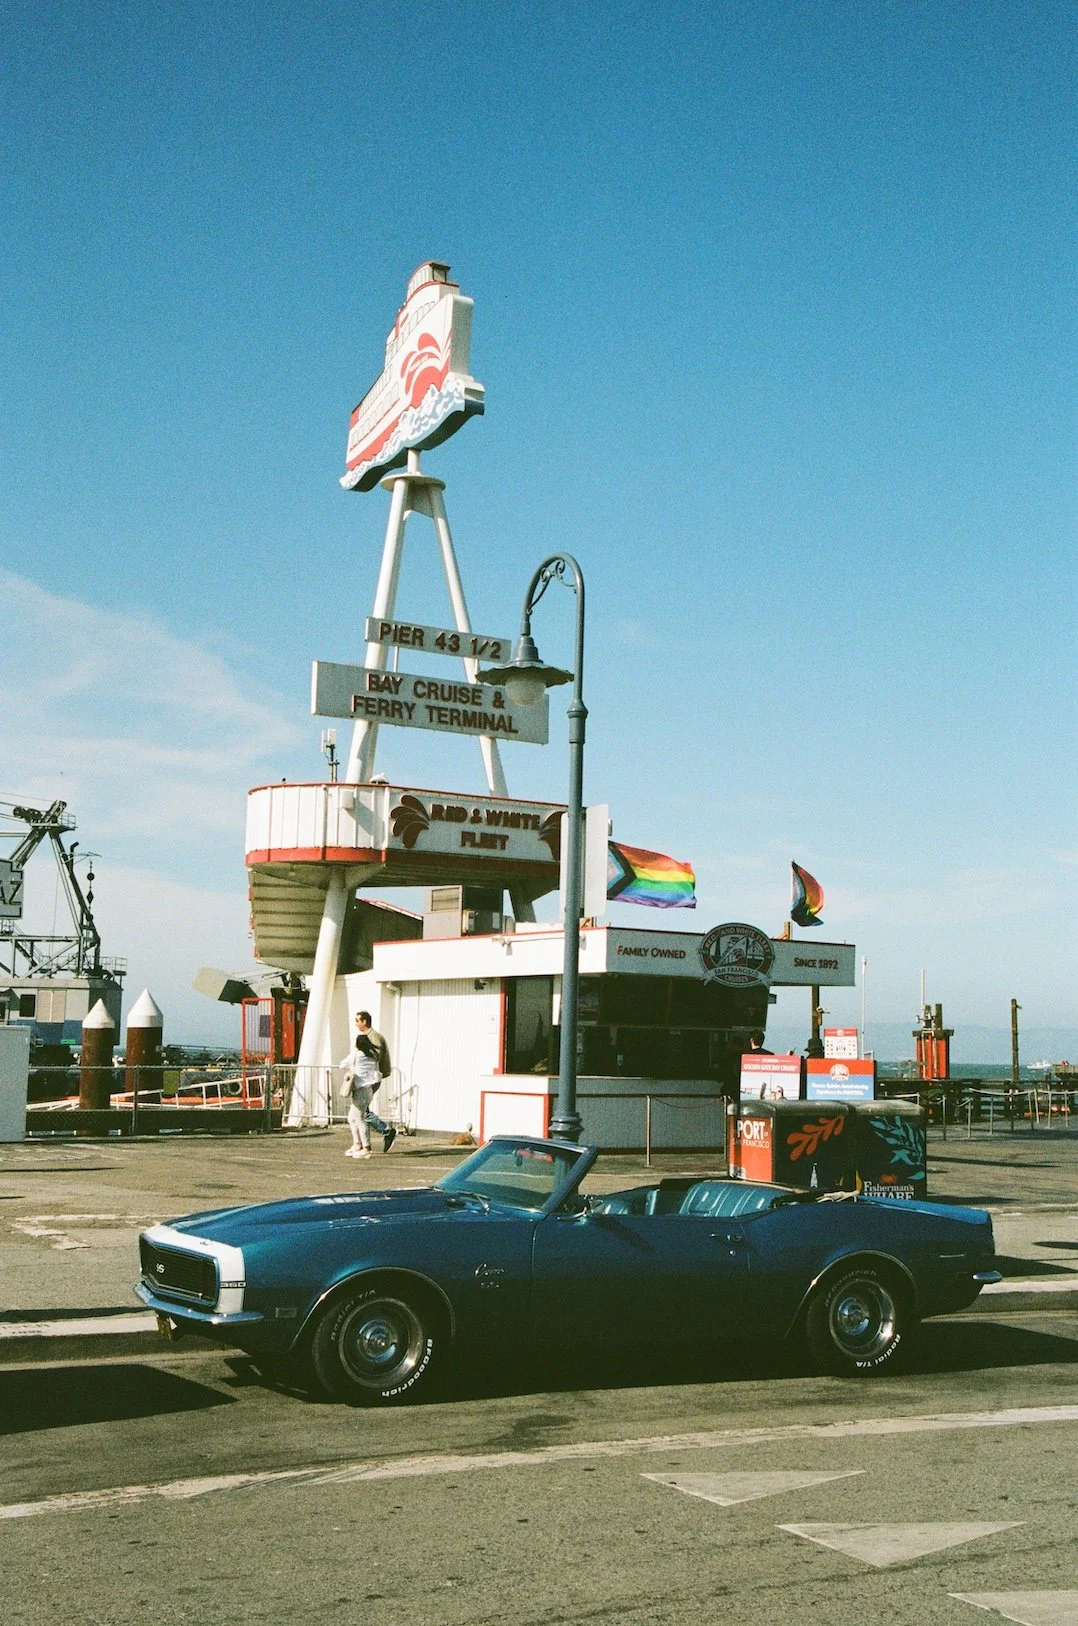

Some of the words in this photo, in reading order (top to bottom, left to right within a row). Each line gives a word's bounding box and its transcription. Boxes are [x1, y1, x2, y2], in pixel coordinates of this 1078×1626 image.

[379, 622, 425, 647] PIER
[435, 632, 460, 653] 43
[470, 637, 501, 659] 1/2
[367, 672, 403, 695] BAY
[413, 680, 483, 706] CRUISE
[493, 690, 505, 709] &
[352, 695, 416, 720] FERRY
[425, 705, 518, 734] TERMINAL
[431, 804, 468, 822] RED
[470, 808, 482, 824] &
[485, 809, 540, 830] WHITE
[461, 831, 509, 850] FLEET
[615, 945, 649, 957] FAMILY
[651, 948, 686, 959] OWNED
[794, 957, 817, 968] SINCE
[818, 959, 839, 970] 1892
[737, 1120, 765, 1140] PORT
[863, 1181, 914, 1192] Fisherman's
[875, 1333, 901, 1365] Radial
[381, 1338, 433, 1397] BFGoodrich
